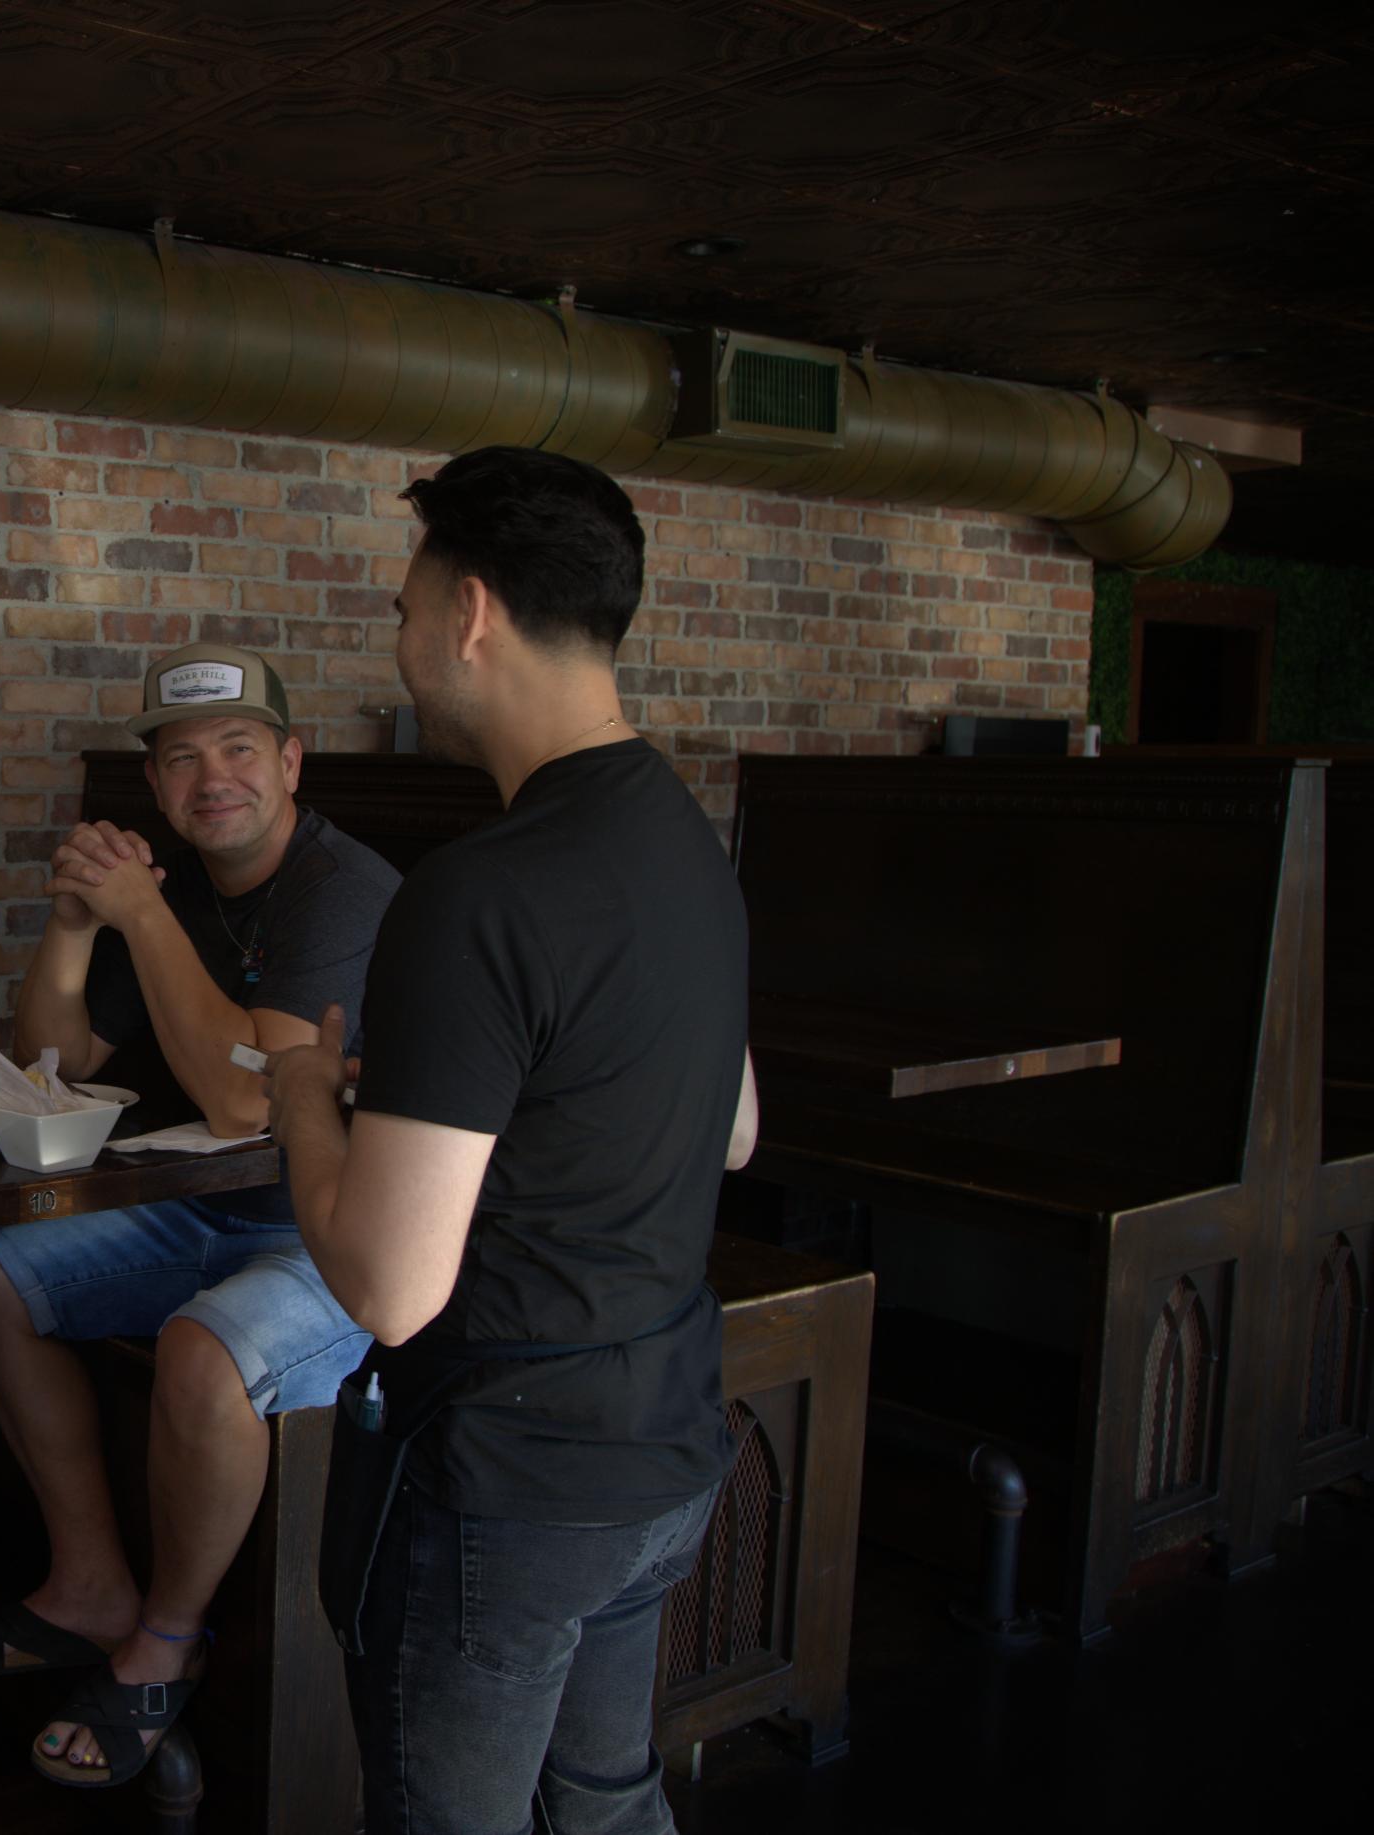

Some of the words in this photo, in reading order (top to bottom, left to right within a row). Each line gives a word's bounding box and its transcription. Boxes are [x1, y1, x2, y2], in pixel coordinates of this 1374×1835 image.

[172, 671, 199, 685] BARR
[201, 670, 228, 681] HILL
[29, 1190, 57, 1215] 10
